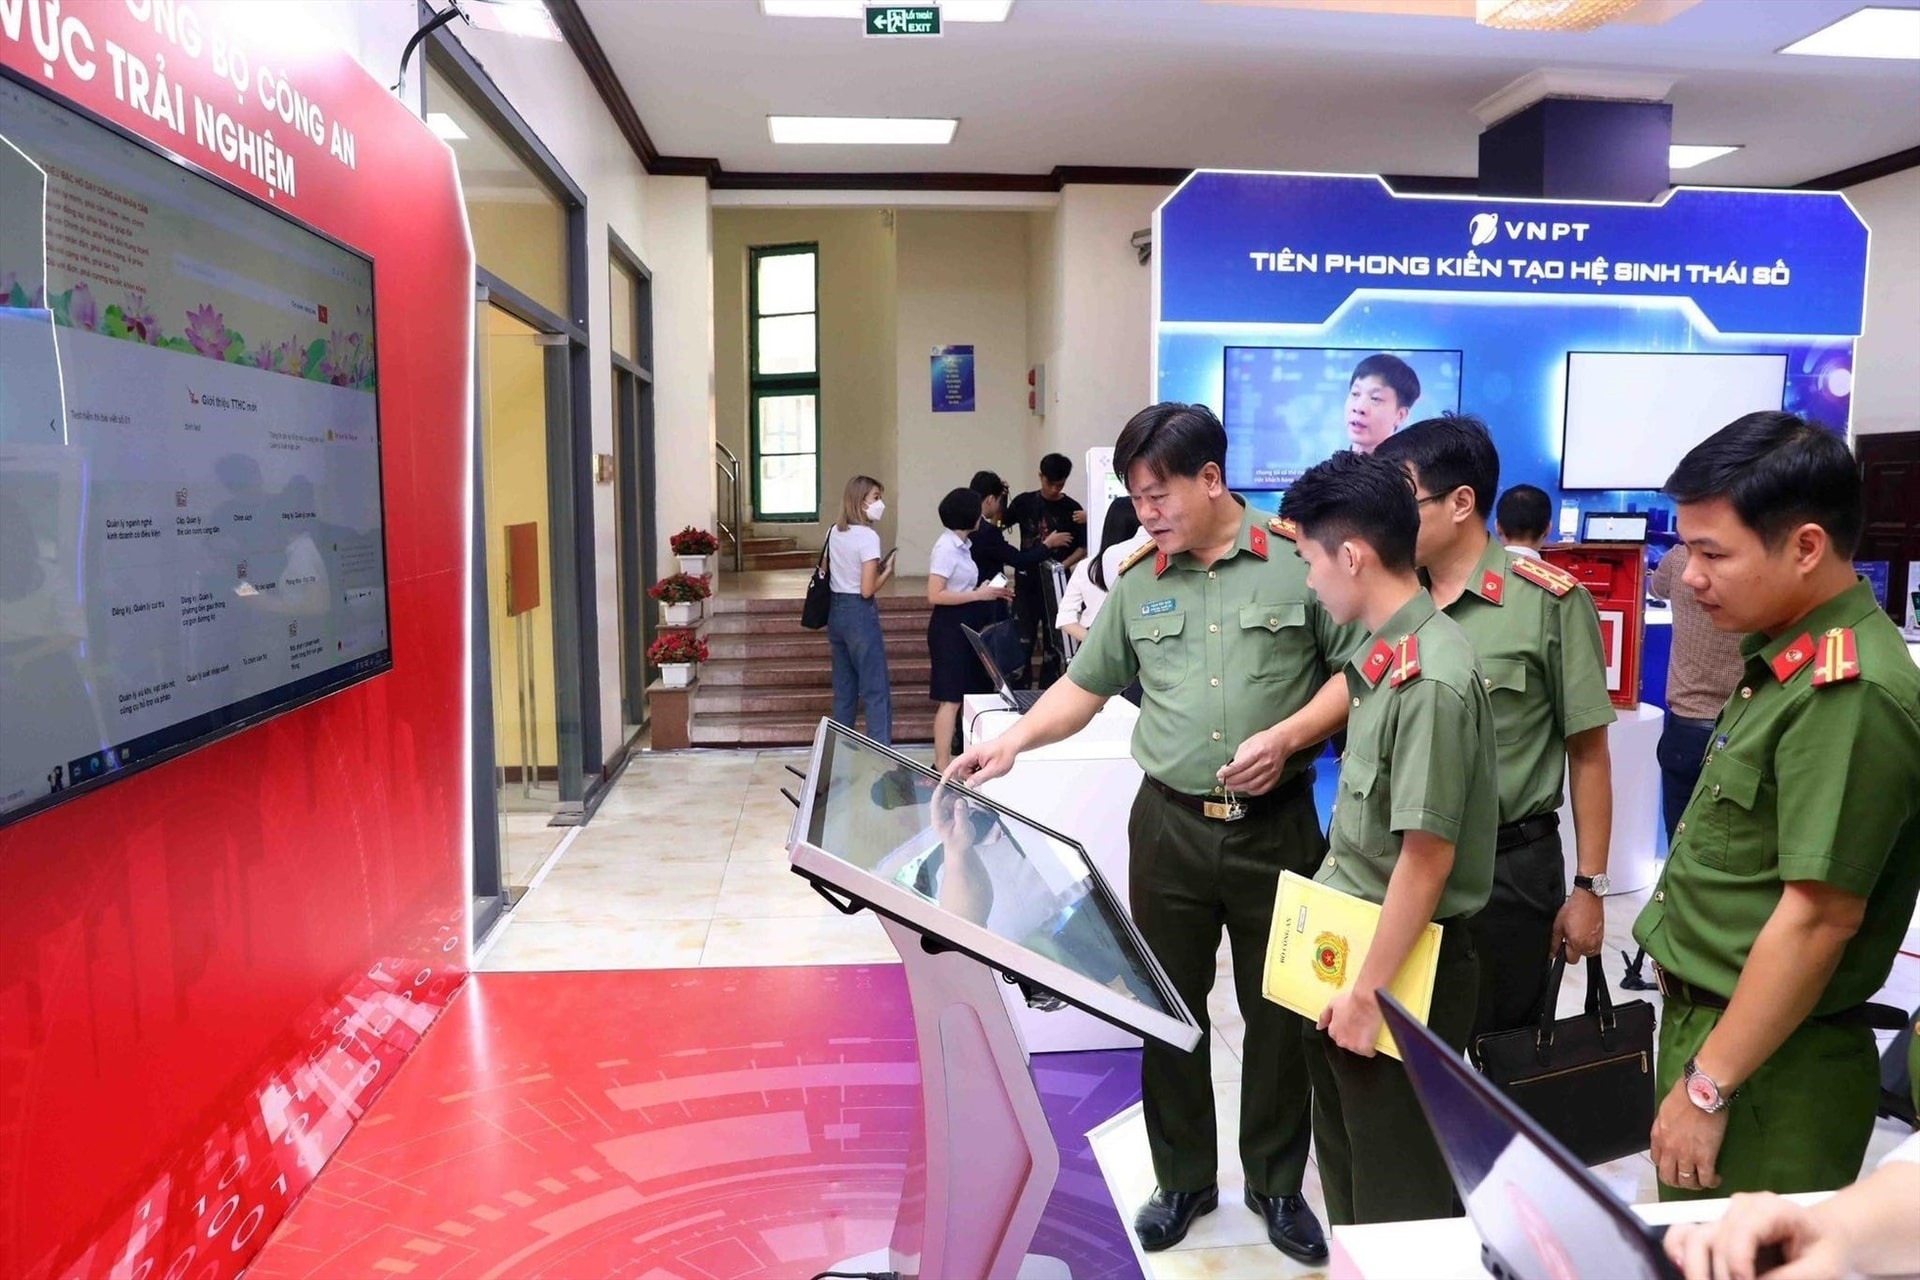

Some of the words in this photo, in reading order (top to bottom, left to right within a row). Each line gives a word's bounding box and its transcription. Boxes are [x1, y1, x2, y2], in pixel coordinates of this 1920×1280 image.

[908, 23, 931, 32] EXIT
[105, 39, 186, 135] TRẢI
[194, 95, 296, 199] NGHIỆM
[257, 64, 325, 146] CÔNG
[330, 120, 356, 170] AN
[1505, 222, 1590, 241] VNPT
[1249, 247, 1317, 272] TIÊN
[1325, 254, 1430, 276] PHONG
[1508, 259, 1564, 284] TẠO
[1570, 256, 1609, 286] HỆ
[1614, 262, 1680, 282] SINH
[1686, 260, 1747, 284] THÁI
[1752, 259, 1790, 285] SỐ
